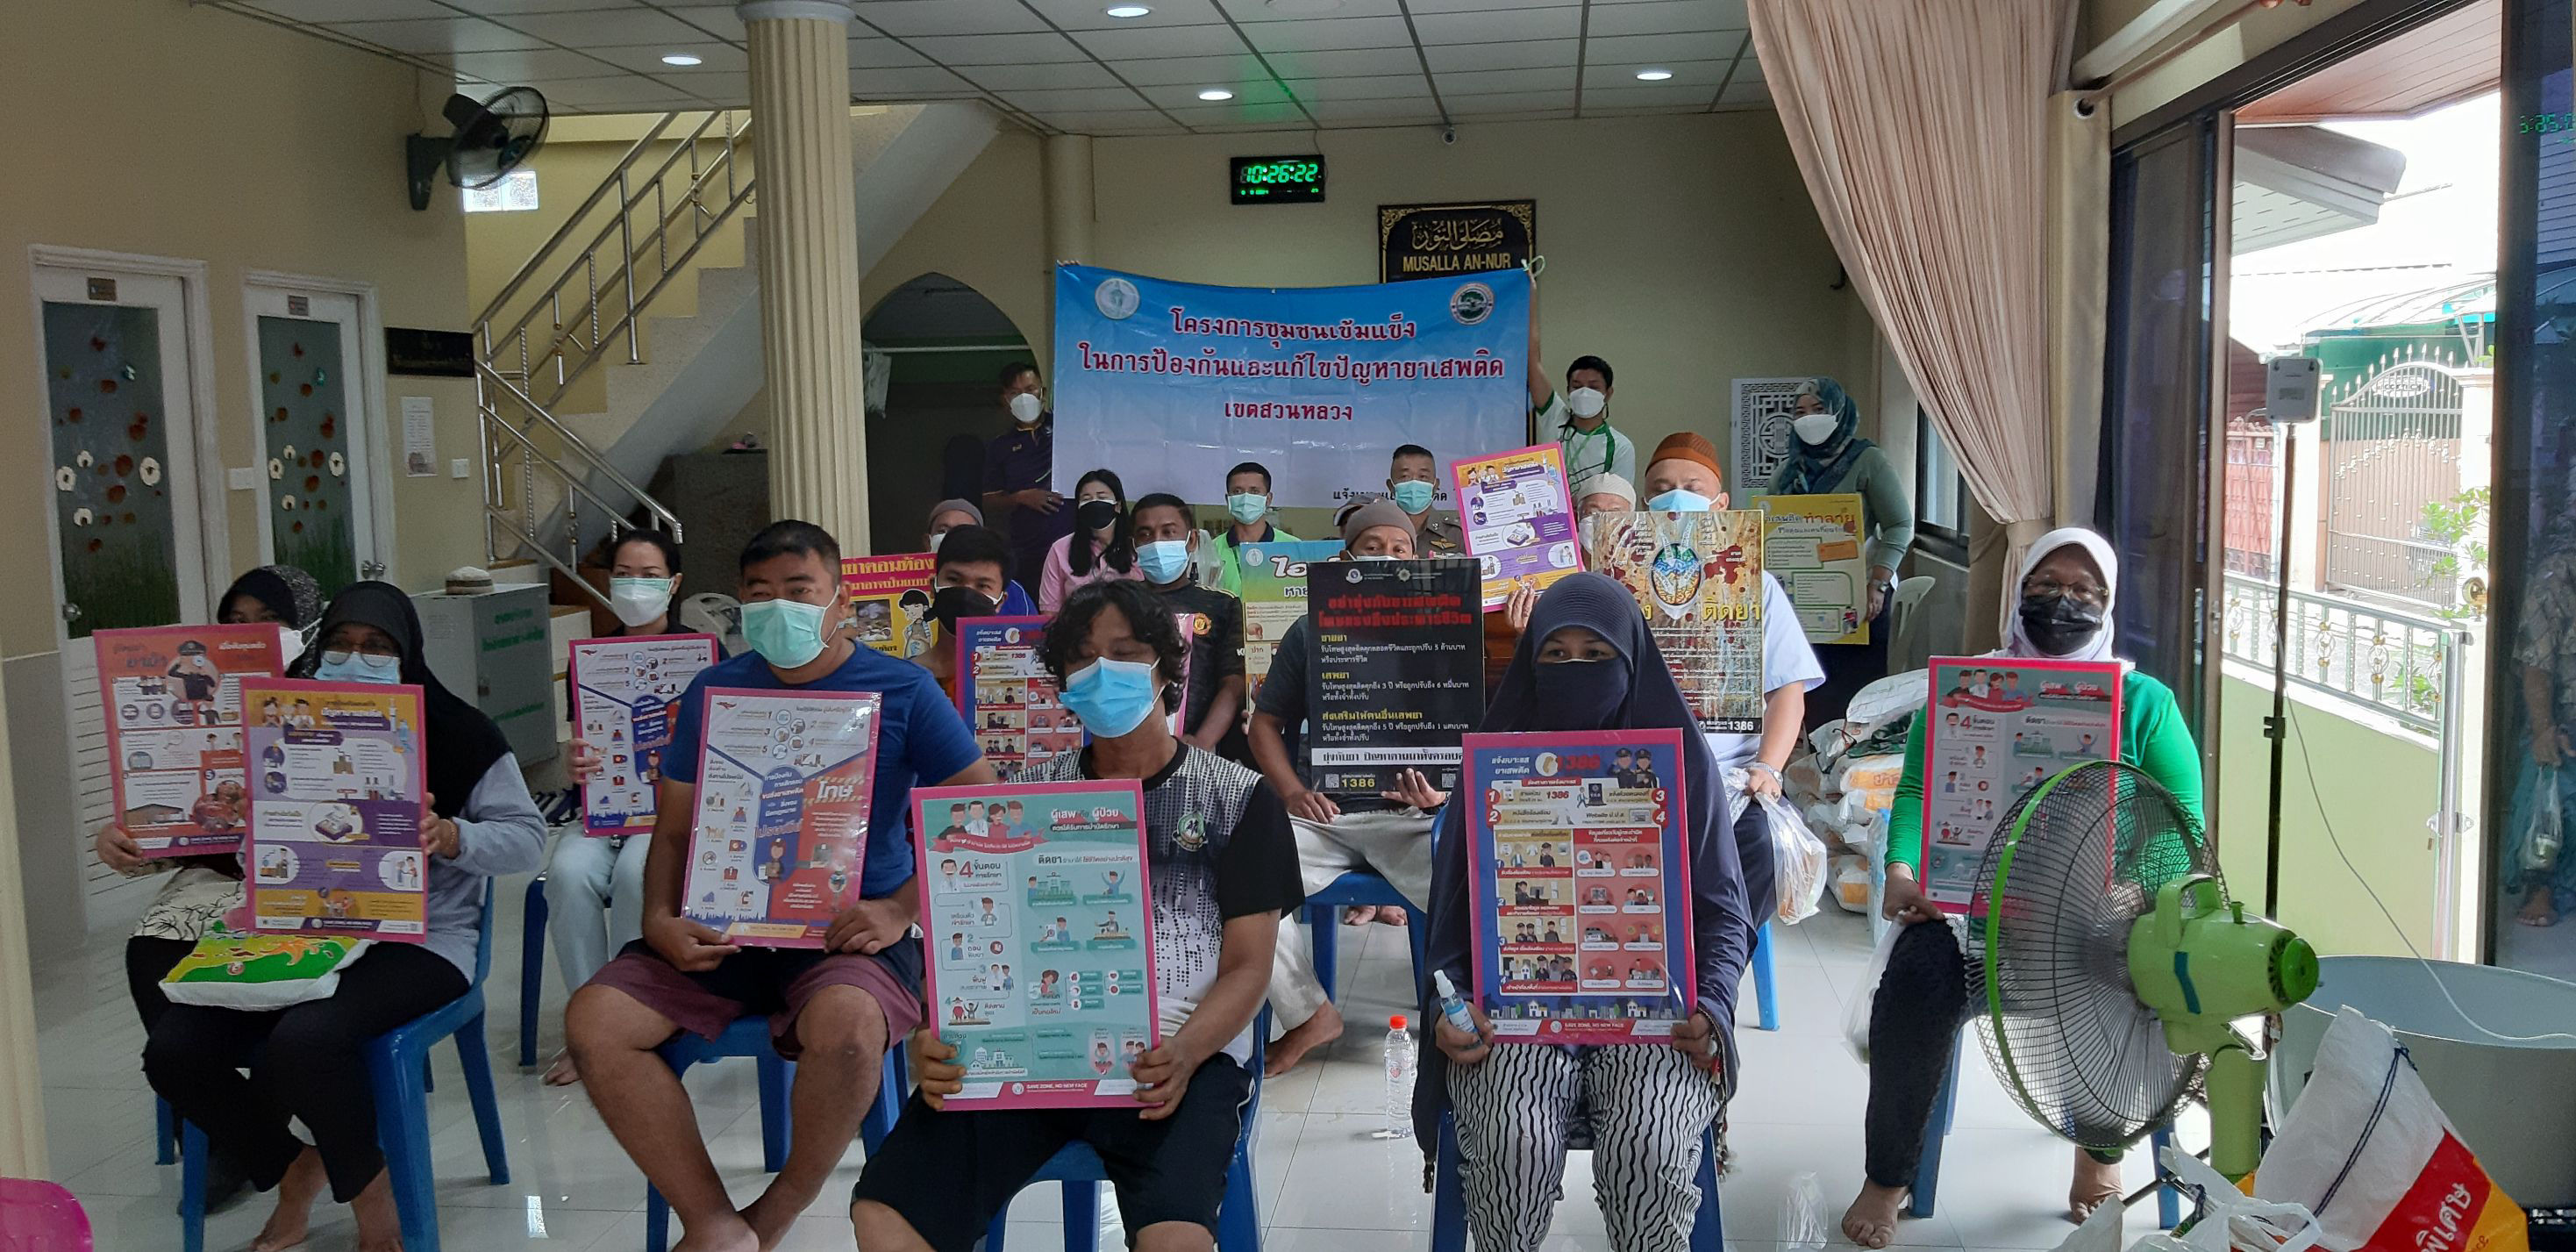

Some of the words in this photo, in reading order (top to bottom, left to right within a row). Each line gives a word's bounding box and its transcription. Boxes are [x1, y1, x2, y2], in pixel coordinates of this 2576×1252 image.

[1248, 163, 1318, 184] 10:26:22
[1402, 255, 1460, 272] MUSALLA
[1463, 252, 1511, 270] AN-NUR
[1169, 306, 1417, 348] โครงการชุมชนเข้มแข็ง
[1079, 340, 1505, 386] ในการป้องกันและแก้ไขปัญหายาเสพติด
[1224, 397, 1353, 422] เขตสวนหลวง
[1702, 597, 1761, 621] ติดยา
[1728, 720, 1754, 731] 1386
[1959, 715, 1972, 729] 4
[817, 780, 854, 799] โทษ
[1341, 778, 1376, 789] 1386
[1488, 791, 1496, 802] 1
[1655, 790, 1665, 802] 3
[1488, 811, 1498, 822] 2
[1656, 812, 1666, 823] 4
[959, 861, 974, 878] 4
[974, 859, 1002, 870] ขั้นตอน
[979, 965, 987, 974] 3
